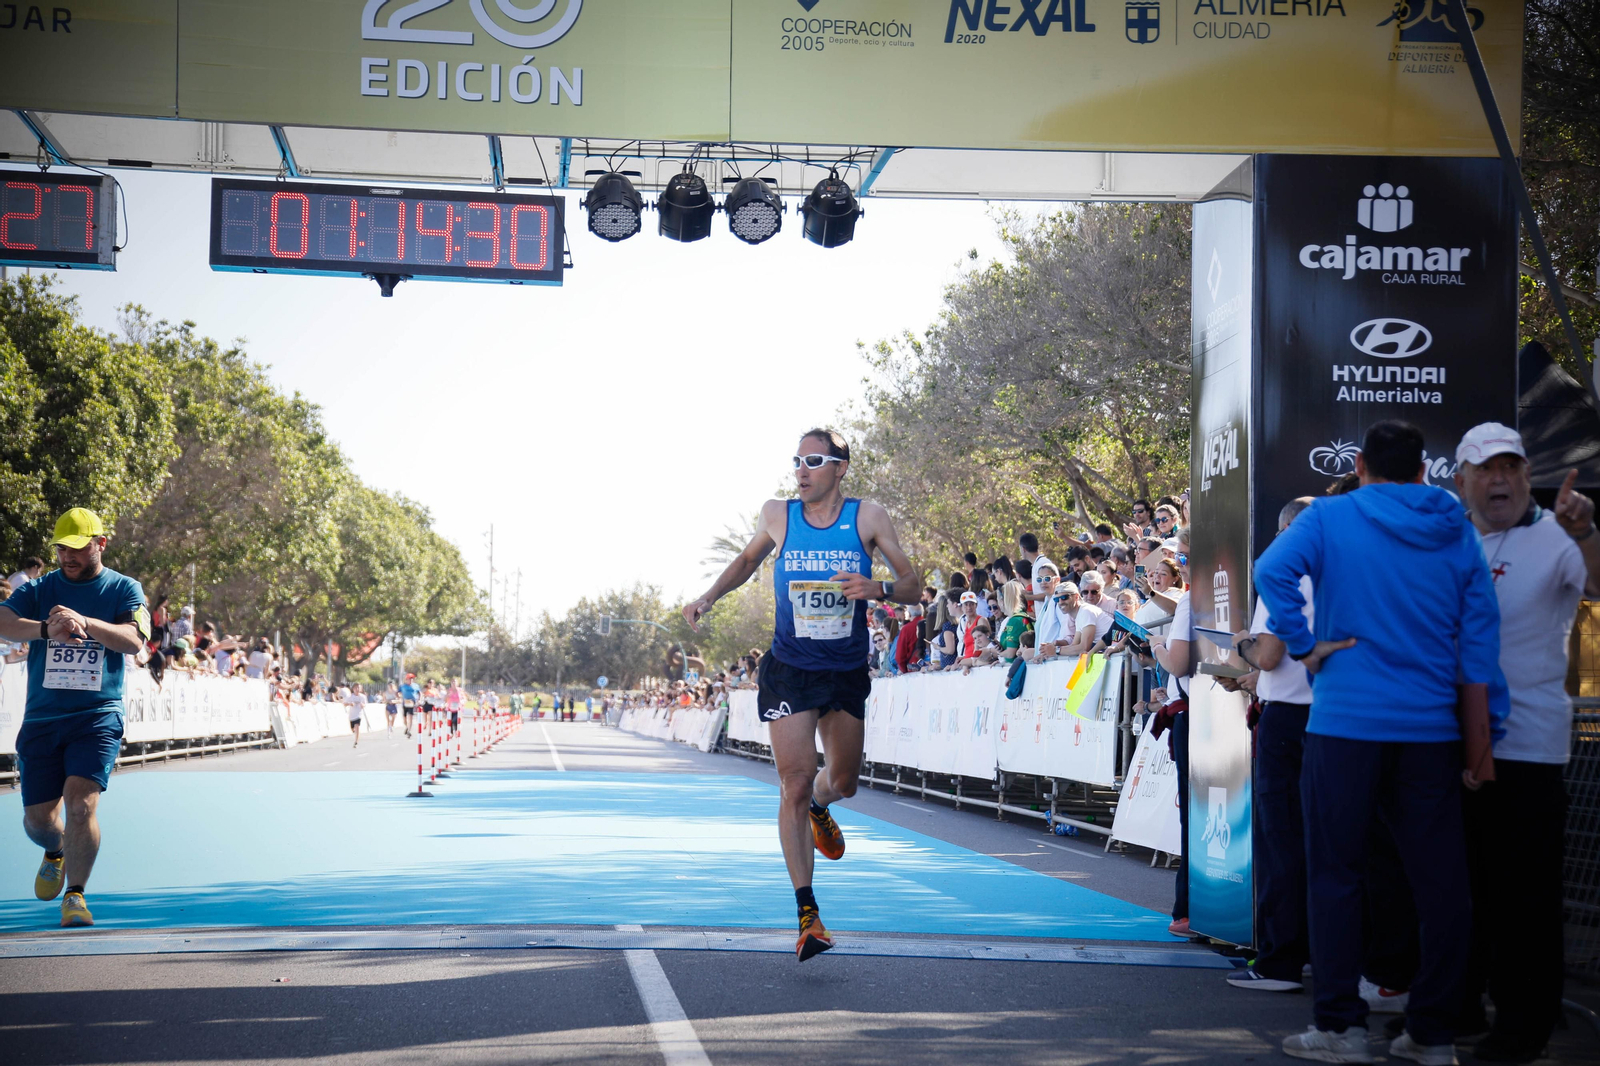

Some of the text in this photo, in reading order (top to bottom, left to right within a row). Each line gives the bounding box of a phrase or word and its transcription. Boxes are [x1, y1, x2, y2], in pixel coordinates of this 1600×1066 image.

[781, 18, 912, 38] COOPERACIÓN
[944, 0, 1096, 44] NEXAL
[1193, 21, 1271, 39] CIUDAD
[781, 35, 825, 51] 2005
[828, 36, 861, 45] Deporte,
[888, 40, 915, 48] cultura
[956, 34, 986, 44] 2020
[1387, 52, 1450, 62] DEPORTES
[1402, 64, 1455, 74] ALMERIA
[361, 55, 583, 106] EDICIÓN
[269, 191, 548, 270] 01:14:30
[1299, 235, 1471, 280] cajamar
[1381, 272, 1466, 285] CAJA RURAL
[1332, 364, 1446, 384] HYUNDAI
[1336, 385, 1443, 404] Almerialva
[1201, 427, 1239, 492] NEXAL
[784, 550, 861, 560] ATLETISMO
[784, 560, 860, 573] BENIDORM
[797, 592, 849, 608] 1504
[53, 649, 98, 664] 5879
